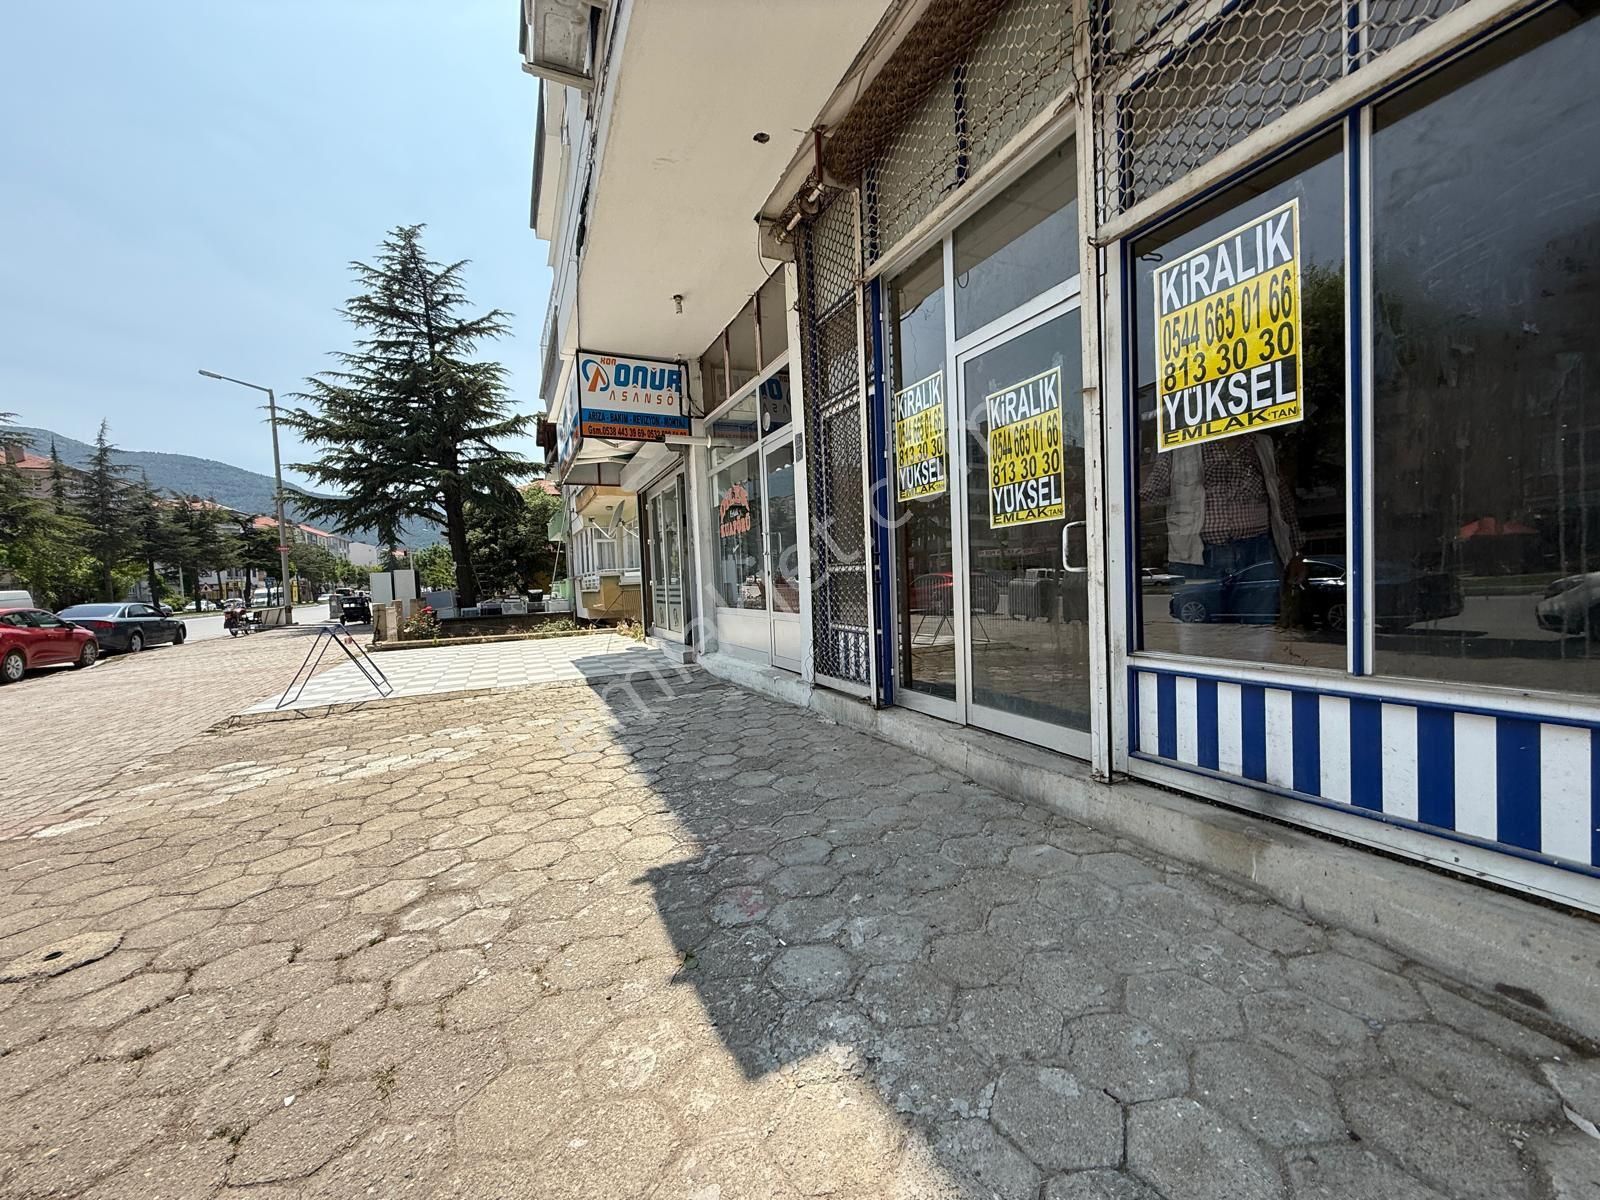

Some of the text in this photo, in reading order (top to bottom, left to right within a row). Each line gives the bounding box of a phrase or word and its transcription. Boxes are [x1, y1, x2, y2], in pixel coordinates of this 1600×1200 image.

[1163, 268, 1293, 362] 0544 665 01 66
[1164, 321, 1295, 392] 813 30 30
[614, 363, 682, 393] ONUR
[1163, 360, 1297, 431] YÜKSEL
[618, 427, 628, 437] 443
[898, 436, 943, 467] 813 30 30
[992, 413, 1059, 464] 0544 665 01 66
[993, 448, 1060, 486] 813 30 30
[993, 475, 1062, 515] YÜKSEL
